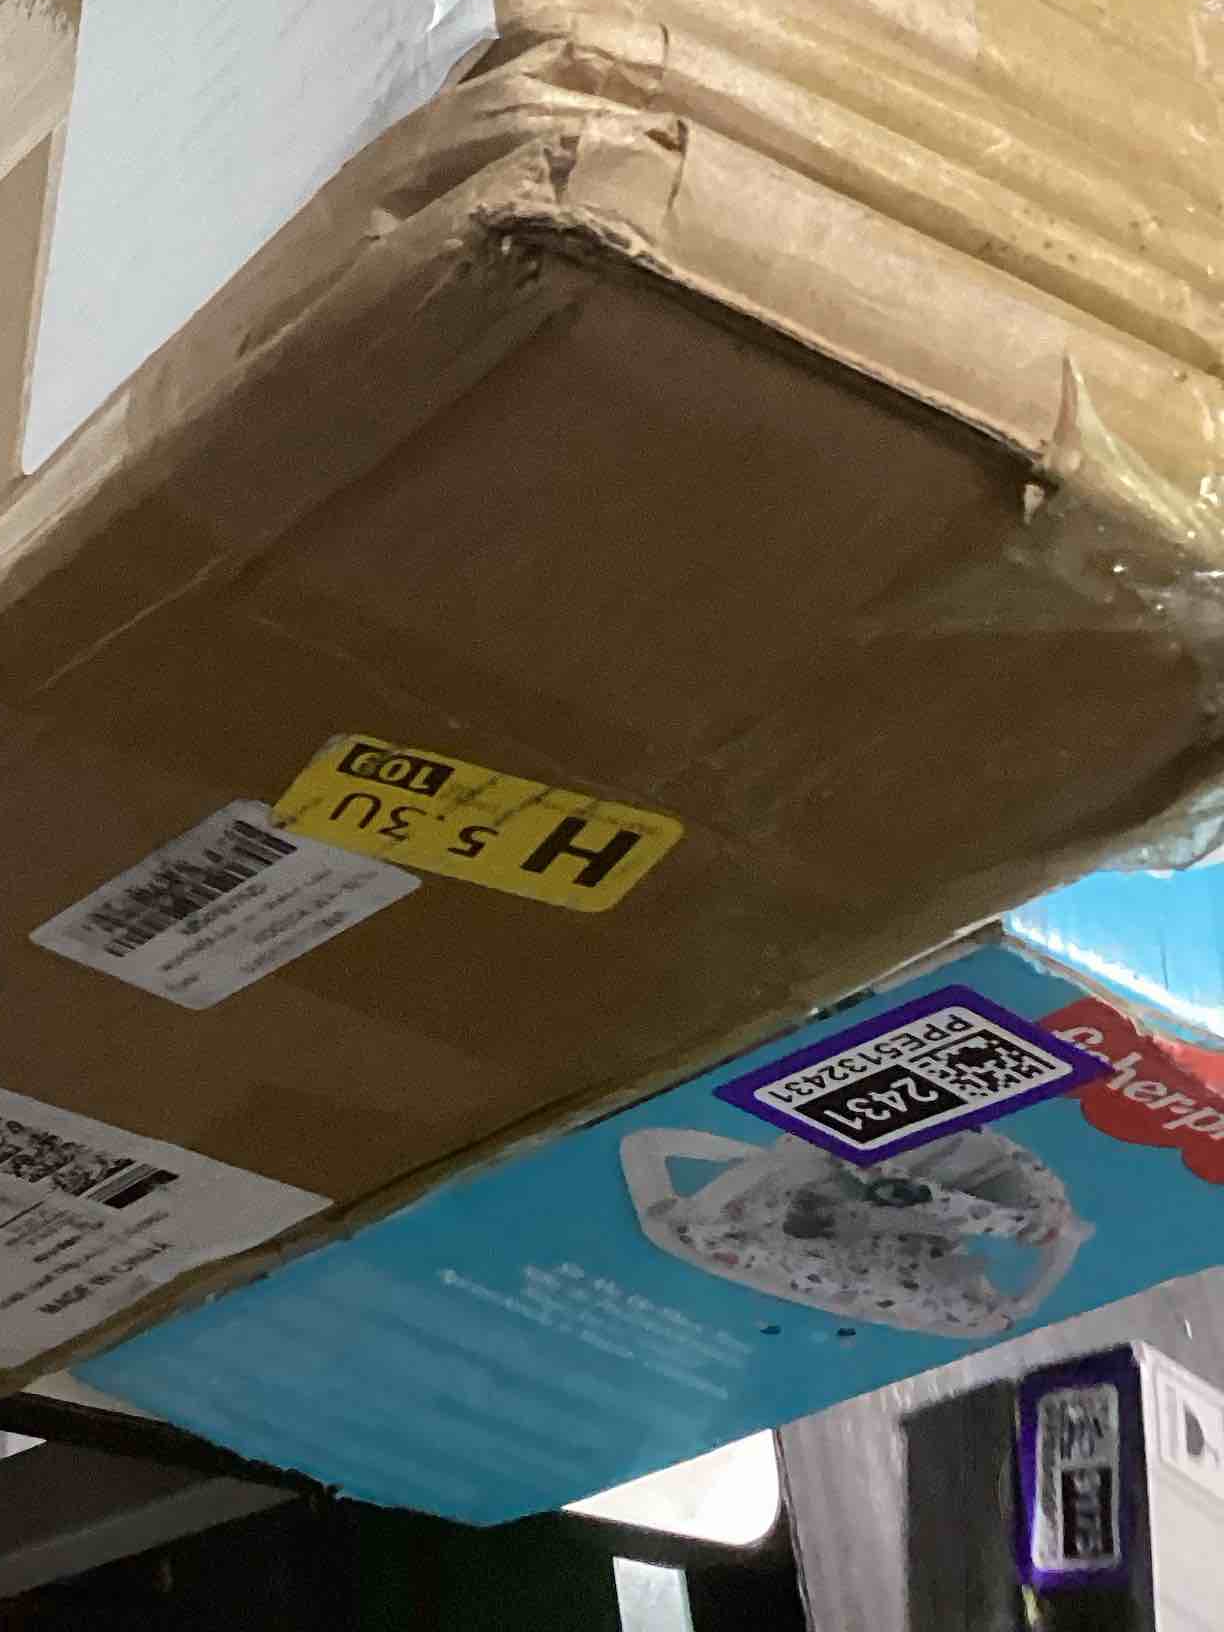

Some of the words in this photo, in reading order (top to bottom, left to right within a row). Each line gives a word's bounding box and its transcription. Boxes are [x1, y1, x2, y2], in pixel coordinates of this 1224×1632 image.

[519, 815, 642, 889] H
[772, 1014, 974, 1105] PPE5132431
[824, 1076, 941, 1133] 2431
